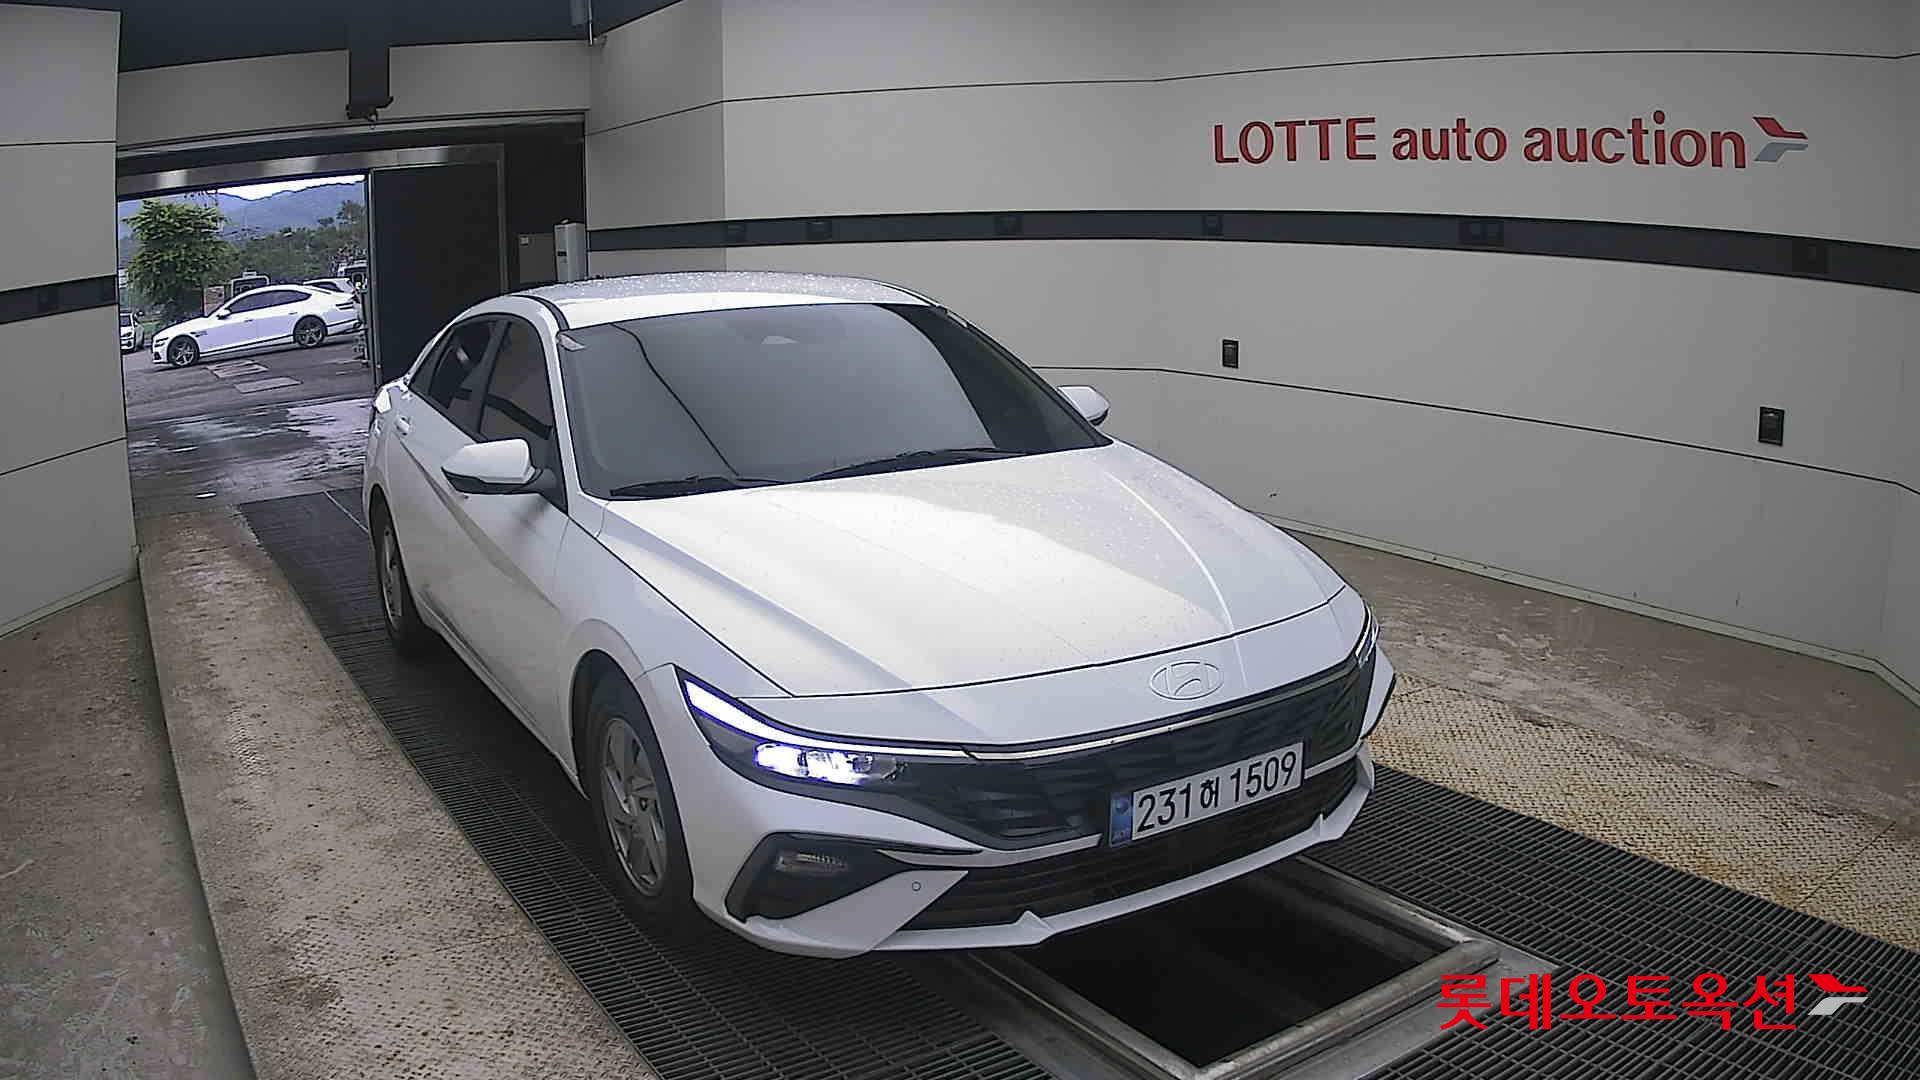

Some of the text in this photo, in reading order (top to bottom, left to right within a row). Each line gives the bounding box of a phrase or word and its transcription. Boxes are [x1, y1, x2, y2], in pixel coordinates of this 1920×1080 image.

[1214, 110, 1747, 169] LOTTE auto auction
[1230, 751, 1297, 802] 1509
